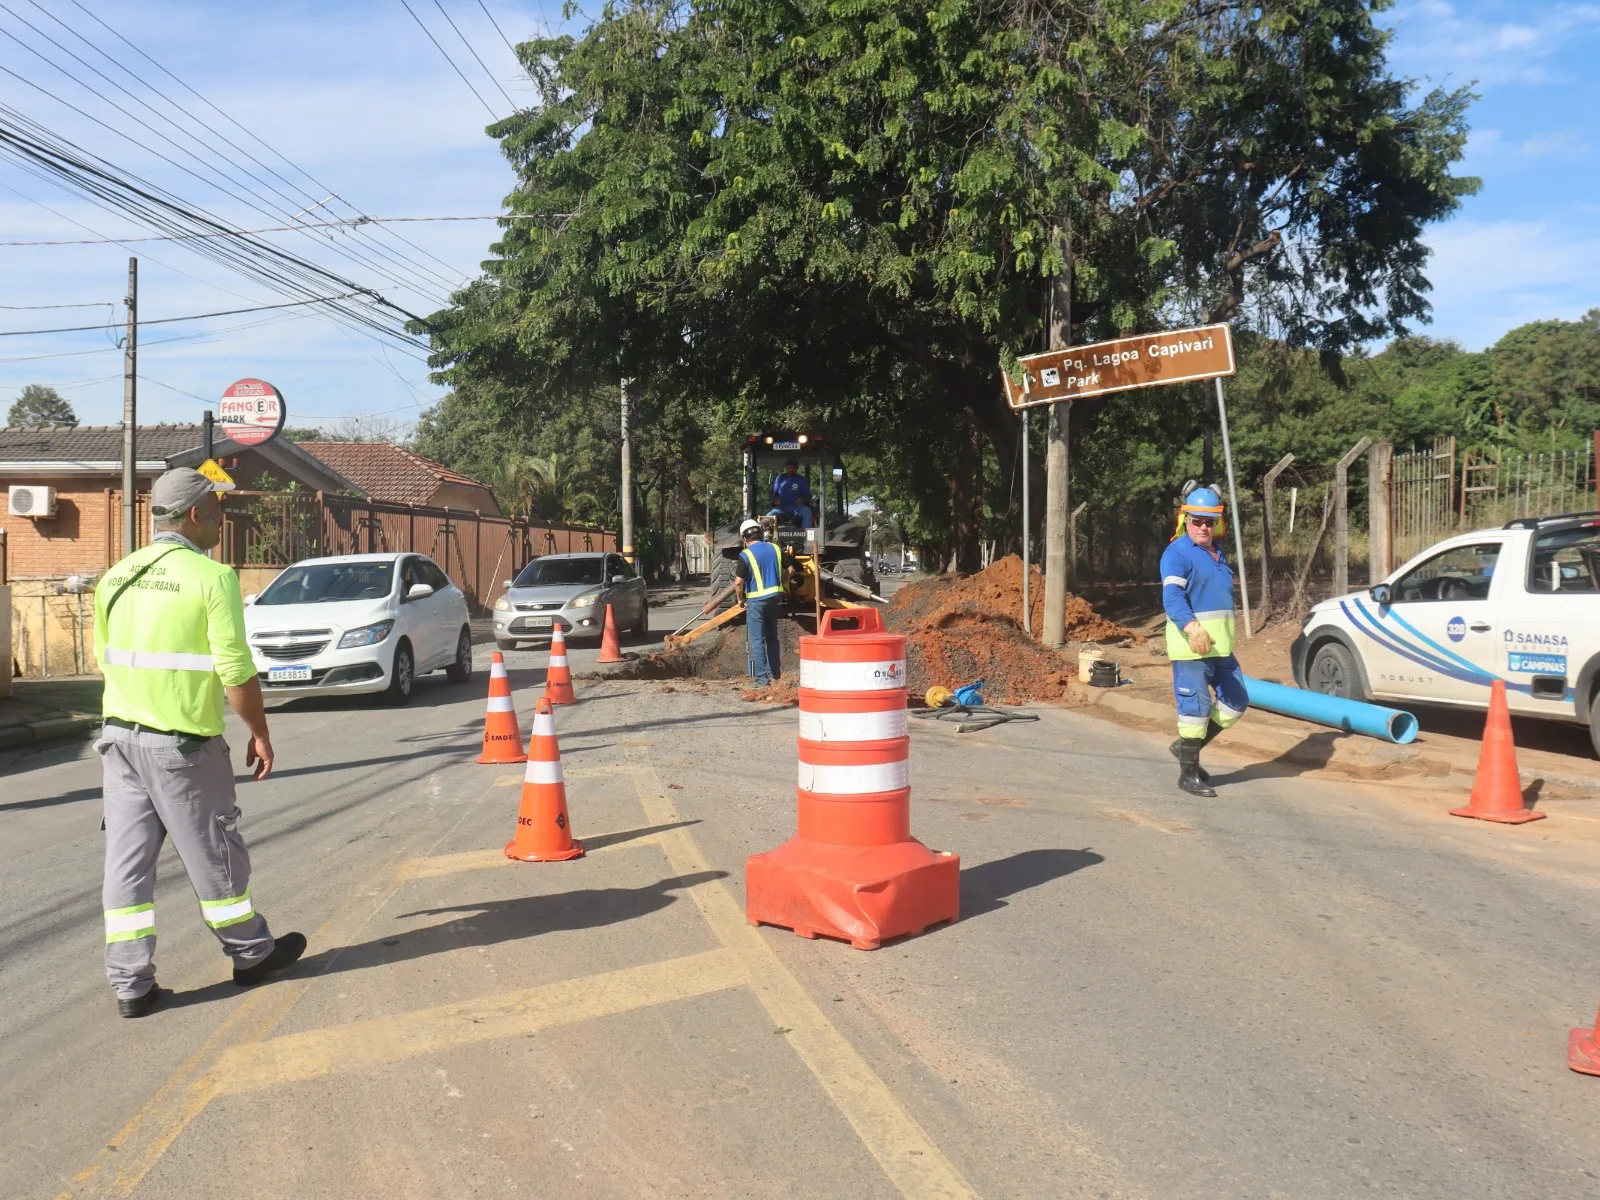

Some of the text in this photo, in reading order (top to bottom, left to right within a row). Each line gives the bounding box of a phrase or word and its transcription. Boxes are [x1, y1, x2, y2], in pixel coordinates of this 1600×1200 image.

[1063, 336, 1214, 372] Pq. Lagoa Capivari
[1067, 372, 1100, 388] Park
[221, 400, 277, 413] FANGER
[221, 414, 246, 424] PARK
[129, 564, 156, 576] AGTE
[150, 579, 181, 593] URBANA
[1446, 623, 1466, 635] 328
[1516, 632, 1569, 646] SANASA
[1521, 659, 1567, 673] CAMPINAS
[1380, 673, 1434, 684] ROBUST
[518, 816, 533, 826] DEC
